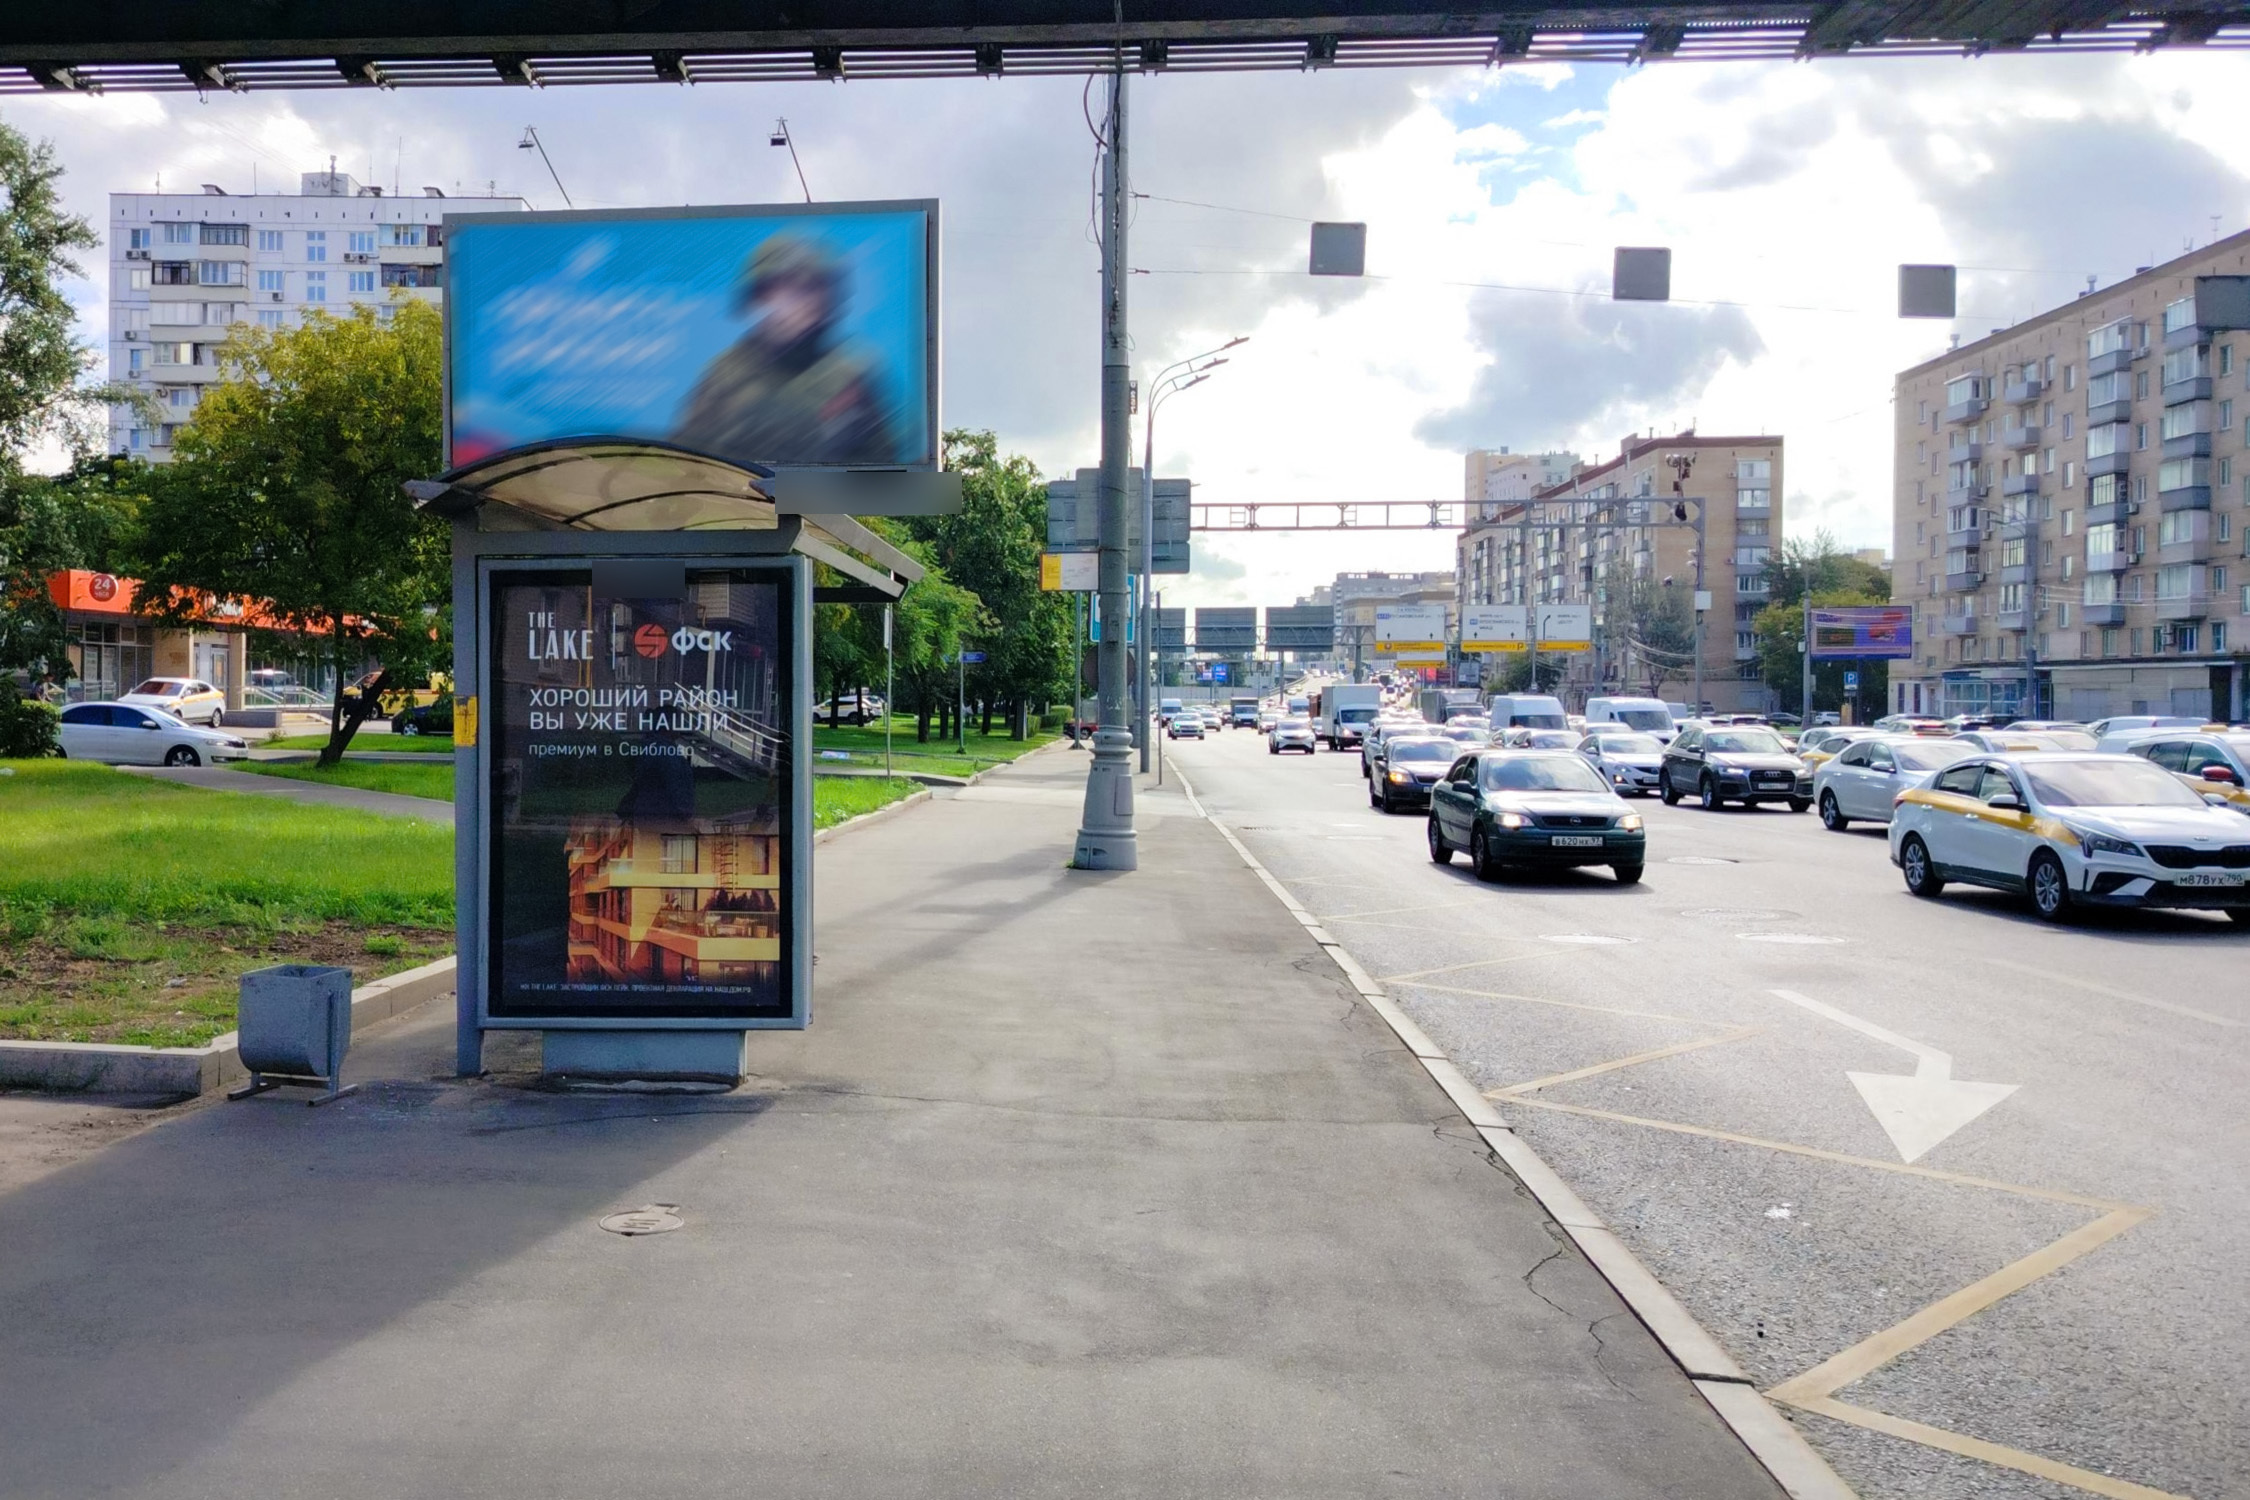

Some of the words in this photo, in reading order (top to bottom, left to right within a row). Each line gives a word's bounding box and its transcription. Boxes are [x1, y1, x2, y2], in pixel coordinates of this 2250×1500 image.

[94, 578, 111, 590] 24
[528, 612, 555, 628] THE
[528, 629, 594, 660] LAKE
[529, 684, 648, 707] ХОРОШИЙ
[659, 684, 738, 707] РАЙОН
[530, 711, 564, 730] ВЫ
[575, 711, 628, 730] УЖЕ
[638, 712, 728, 731] НАШЛИ
[528, 744, 597, 759] премиум
[603, 745, 613, 756] в
[618, 741, 695, 757] Свиблово
